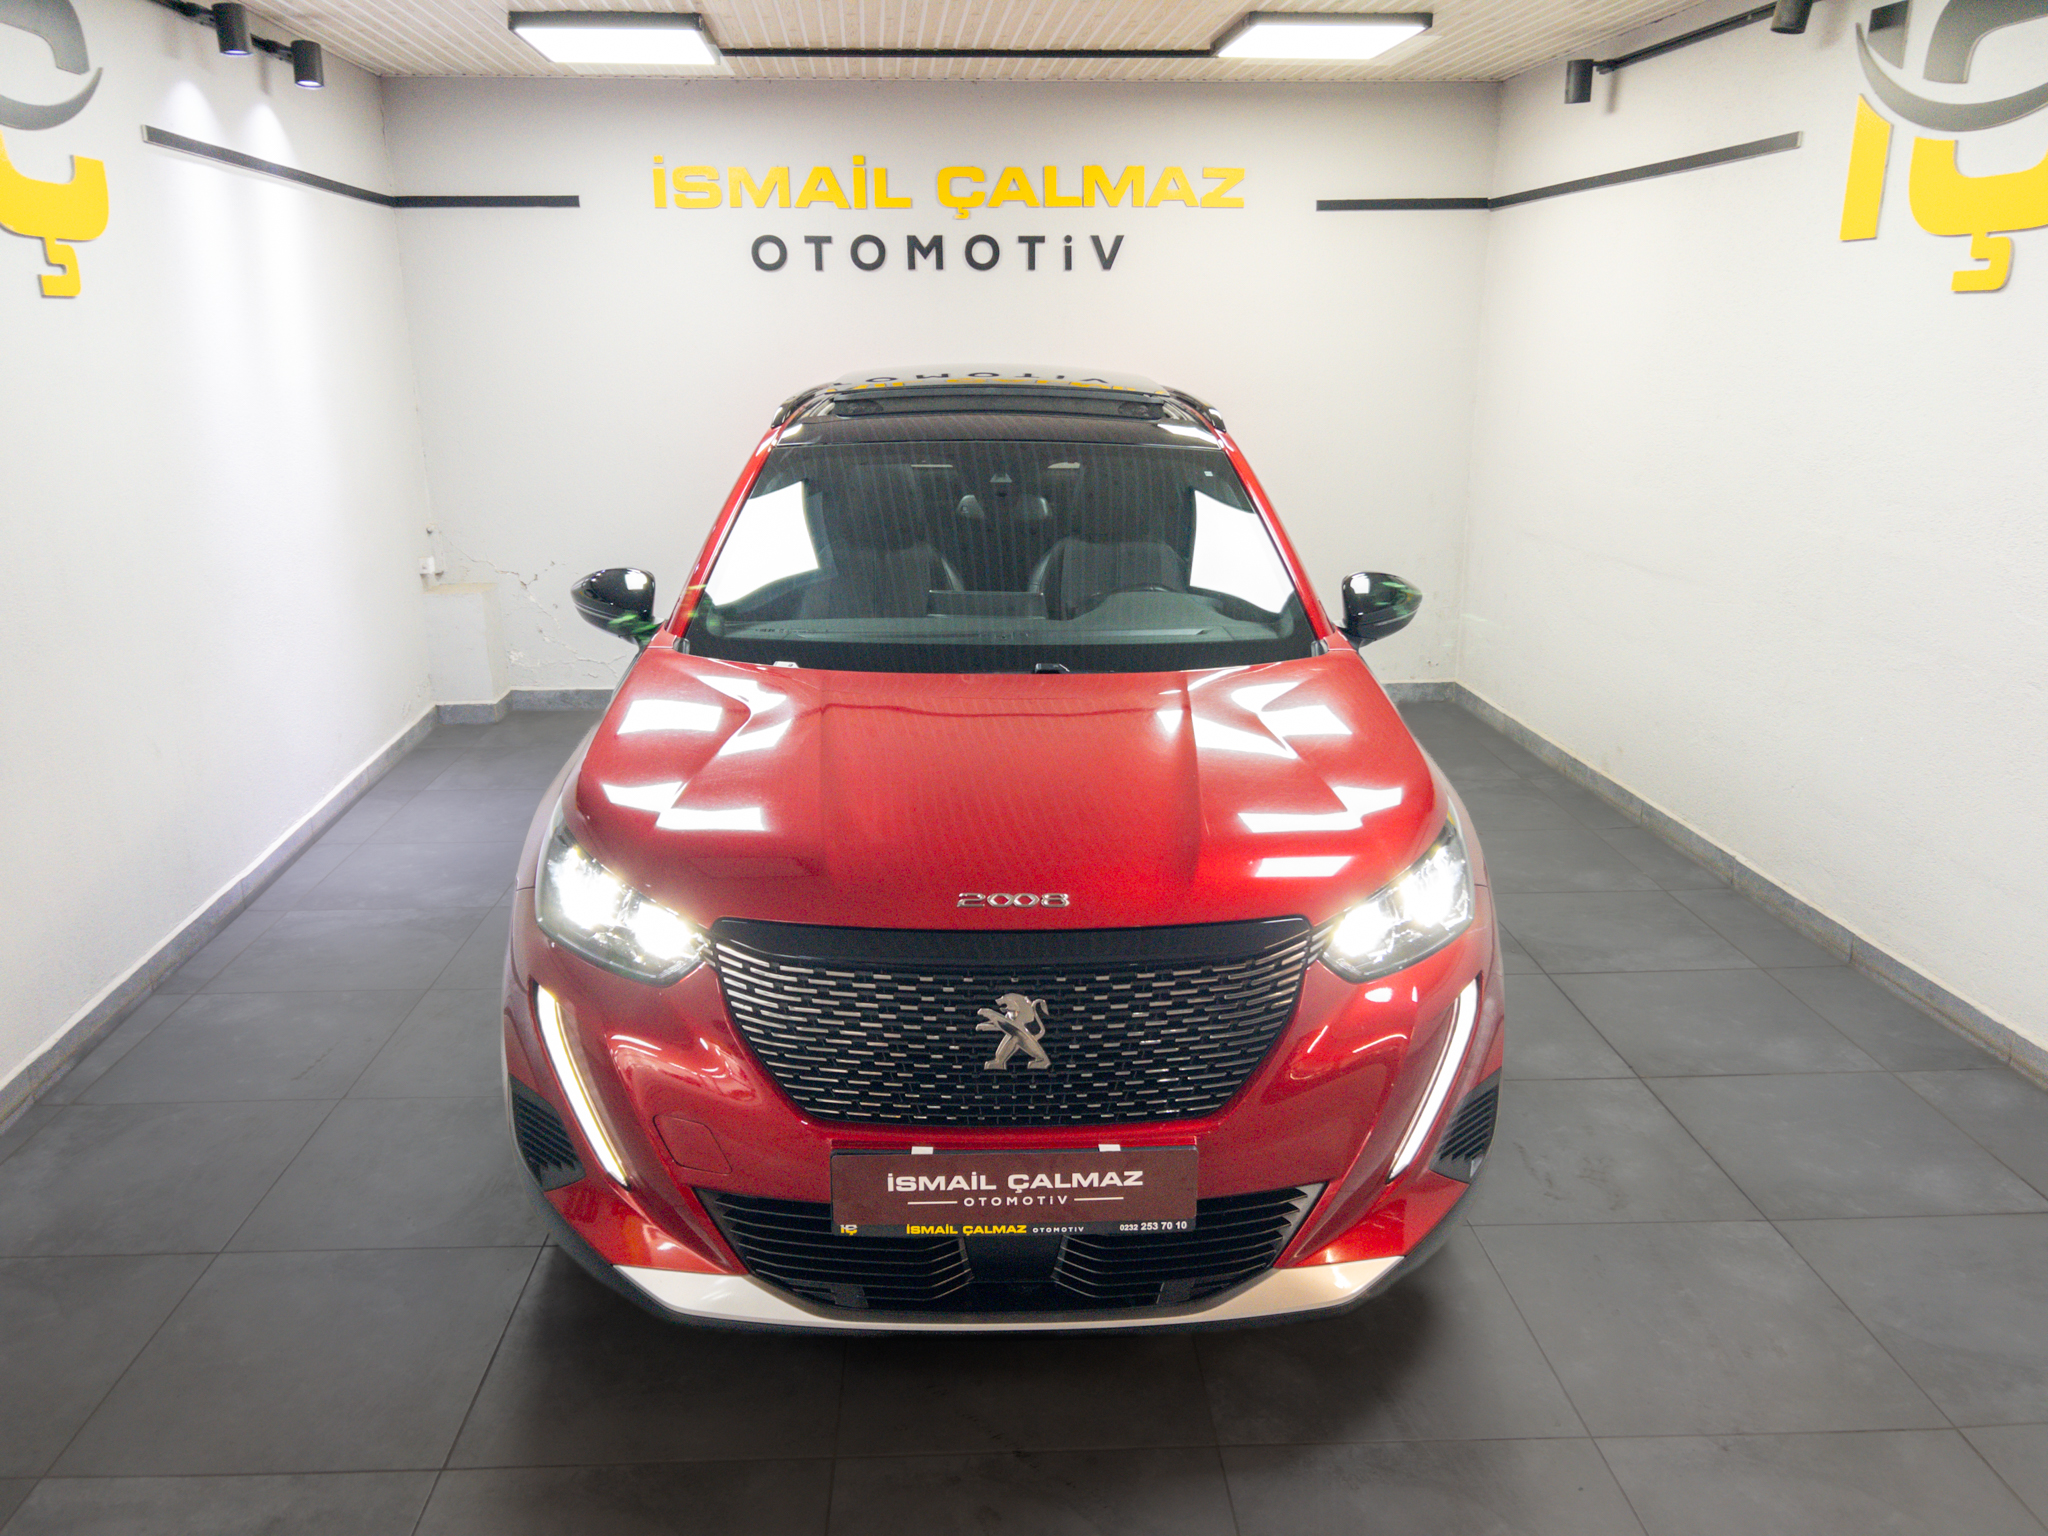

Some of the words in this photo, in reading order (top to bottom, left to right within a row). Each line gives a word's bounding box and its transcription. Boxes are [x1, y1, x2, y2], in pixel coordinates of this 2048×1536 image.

[936, 164, 1246, 220] ÇALMAZ
[956, 892, 1071, 908] 2008
[1007, 1171, 1144, 1193] ÇALMAZ
[962, 1224, 1028, 1237] ÇALMAZ
[1119, 1223, 1139, 1232] 0232
[1140, 1221, 1159, 1231] 253
[1160, 1221, 1173, 1230] 70
[1175, 1220, 1188, 1230] 10
